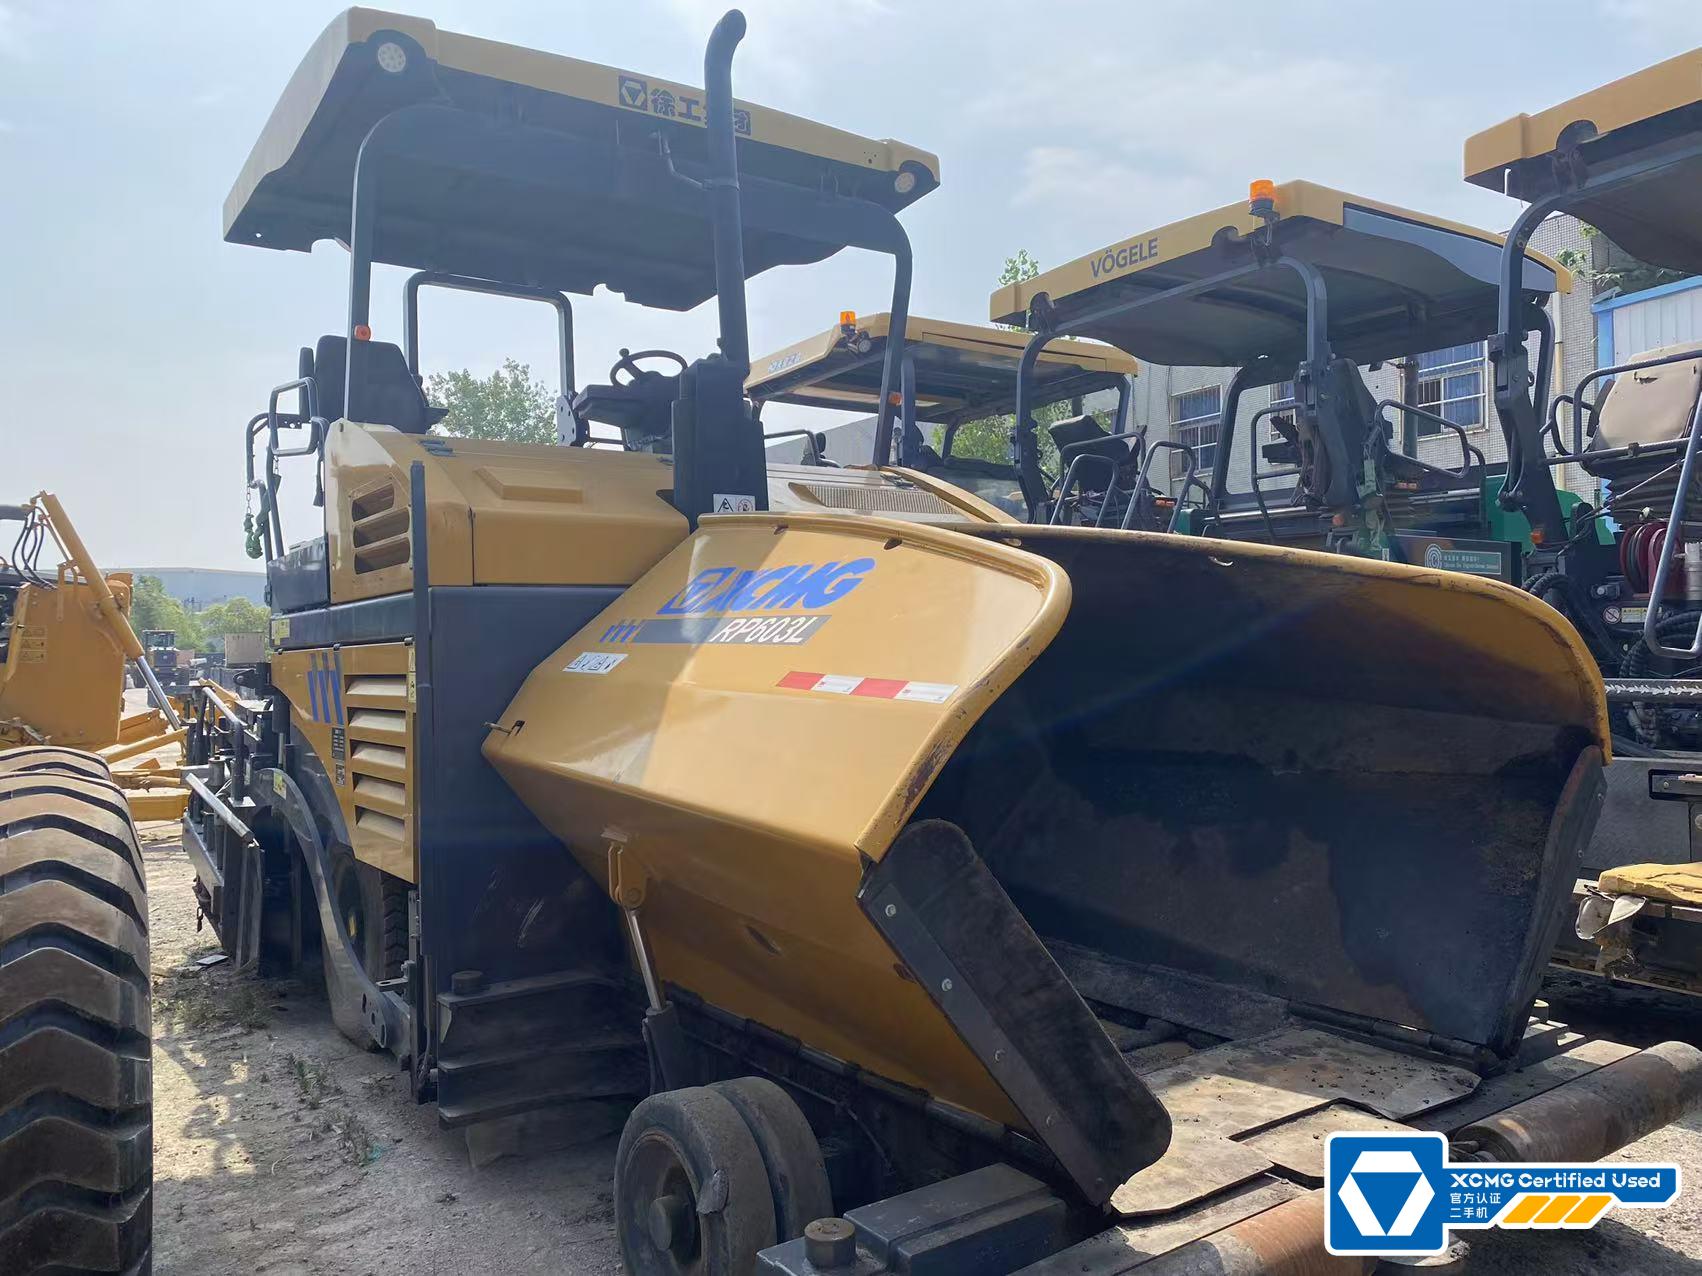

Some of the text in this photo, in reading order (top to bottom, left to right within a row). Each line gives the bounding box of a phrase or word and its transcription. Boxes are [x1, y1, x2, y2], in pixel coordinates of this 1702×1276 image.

[650, 87, 751, 136] 徐工团
[1090, 237, 1158, 278] VÖGELE
[692, 557, 876, 613] XCMG
[709, 616, 818, 643] RP603L
